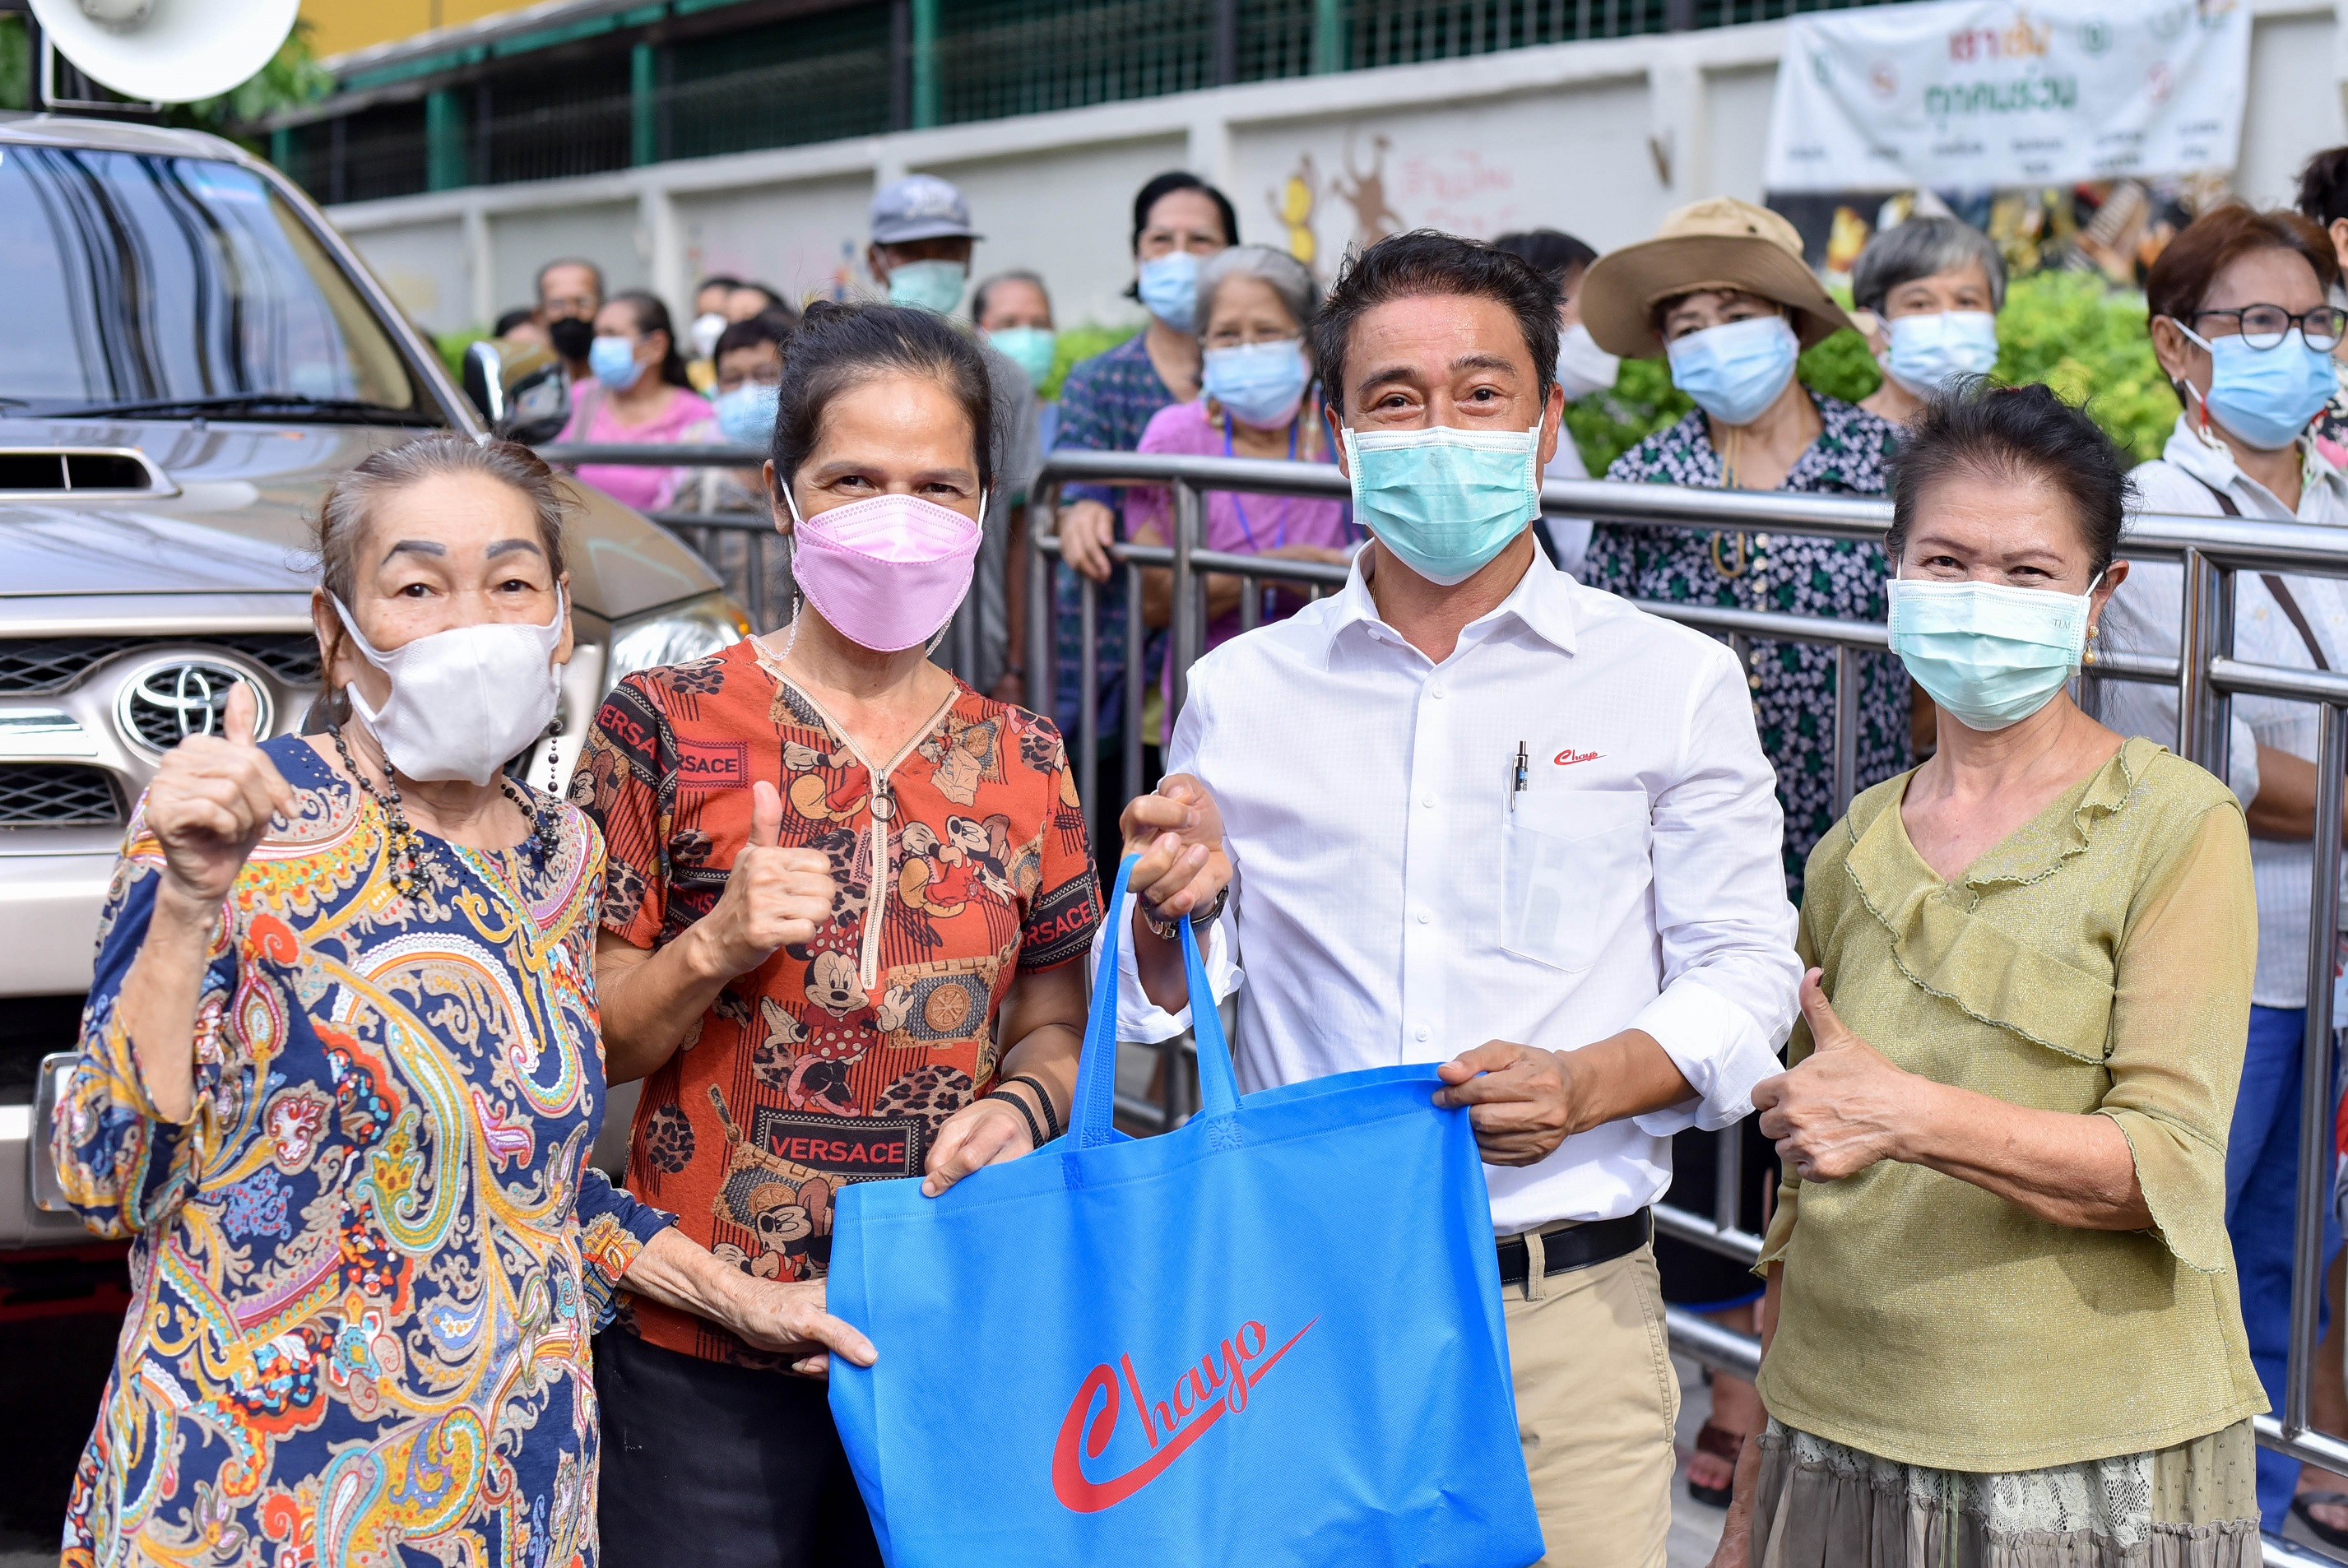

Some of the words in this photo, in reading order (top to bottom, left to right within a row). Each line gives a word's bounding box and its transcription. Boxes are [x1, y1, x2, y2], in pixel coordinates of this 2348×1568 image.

[2053, 618, 2071, 630] TLM
[596, 703, 670, 777] ERSA
[676, 754, 739, 774] RSACE
[1553, 749, 1608, 766] Chayo
[1023, 900, 1093, 948] RSACE
[771, 1134, 906, 1164] VERSACE
[1051, 1312, 1323, 1515] Chayo
